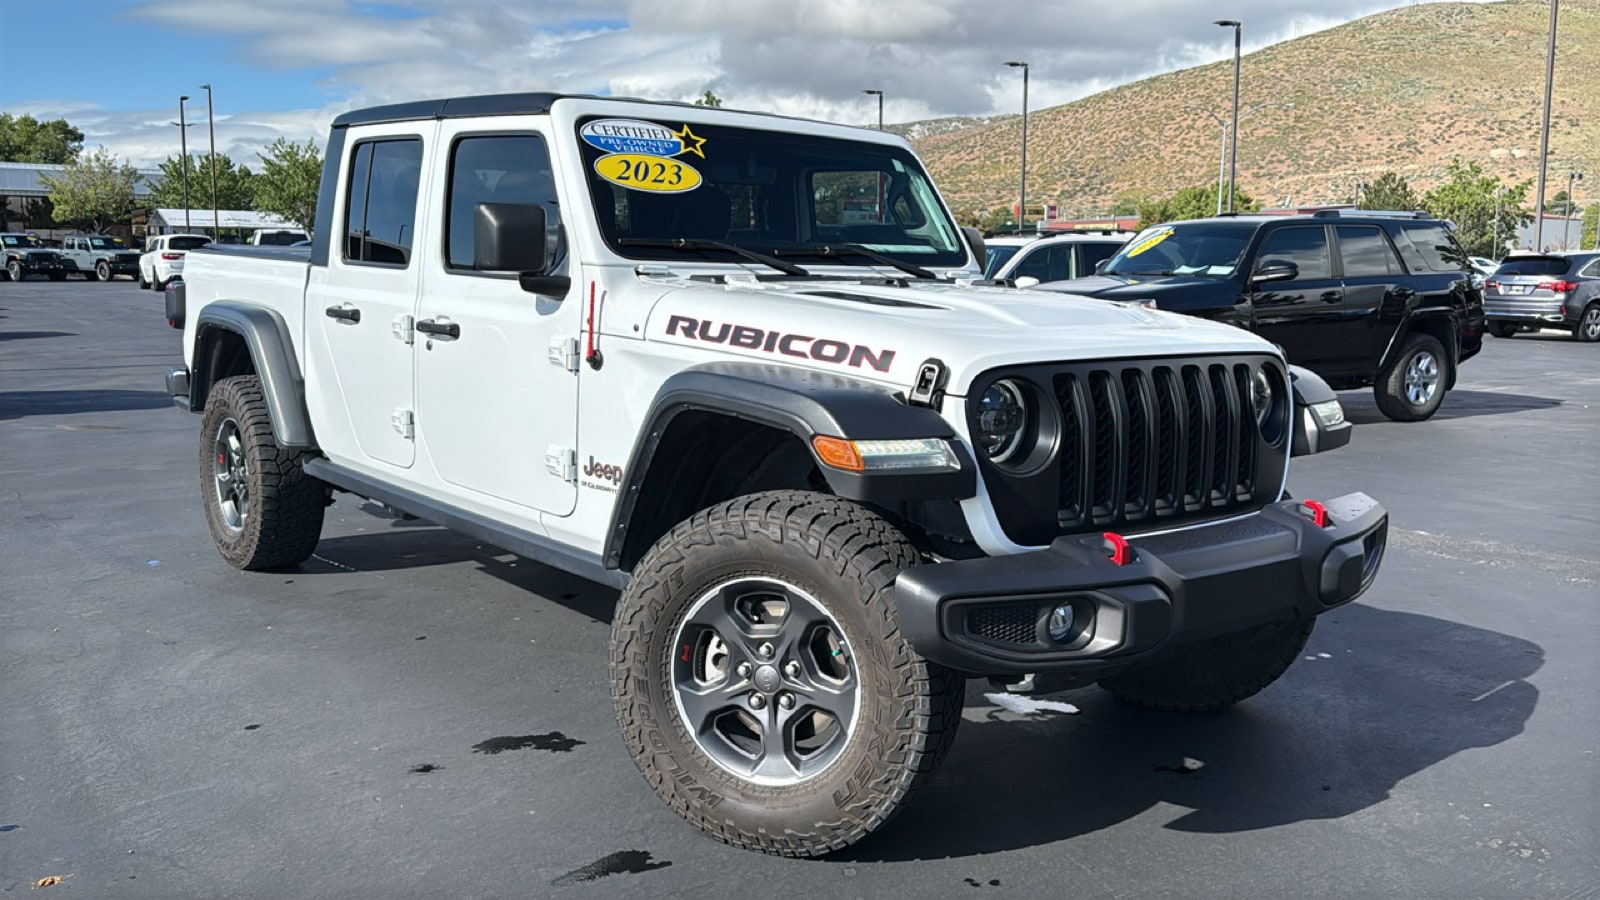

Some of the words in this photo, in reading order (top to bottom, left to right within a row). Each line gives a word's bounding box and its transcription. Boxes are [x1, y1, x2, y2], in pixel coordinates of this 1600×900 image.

[590, 124, 674, 140] CERTIFIED
[600, 137, 674, 149] PRE-OWNED
[613, 144, 667, 155] VEHICLE
[616, 159, 683, 185] 2023
[665, 315, 896, 373] RUBICON
[583, 455, 624, 486] Jeep
